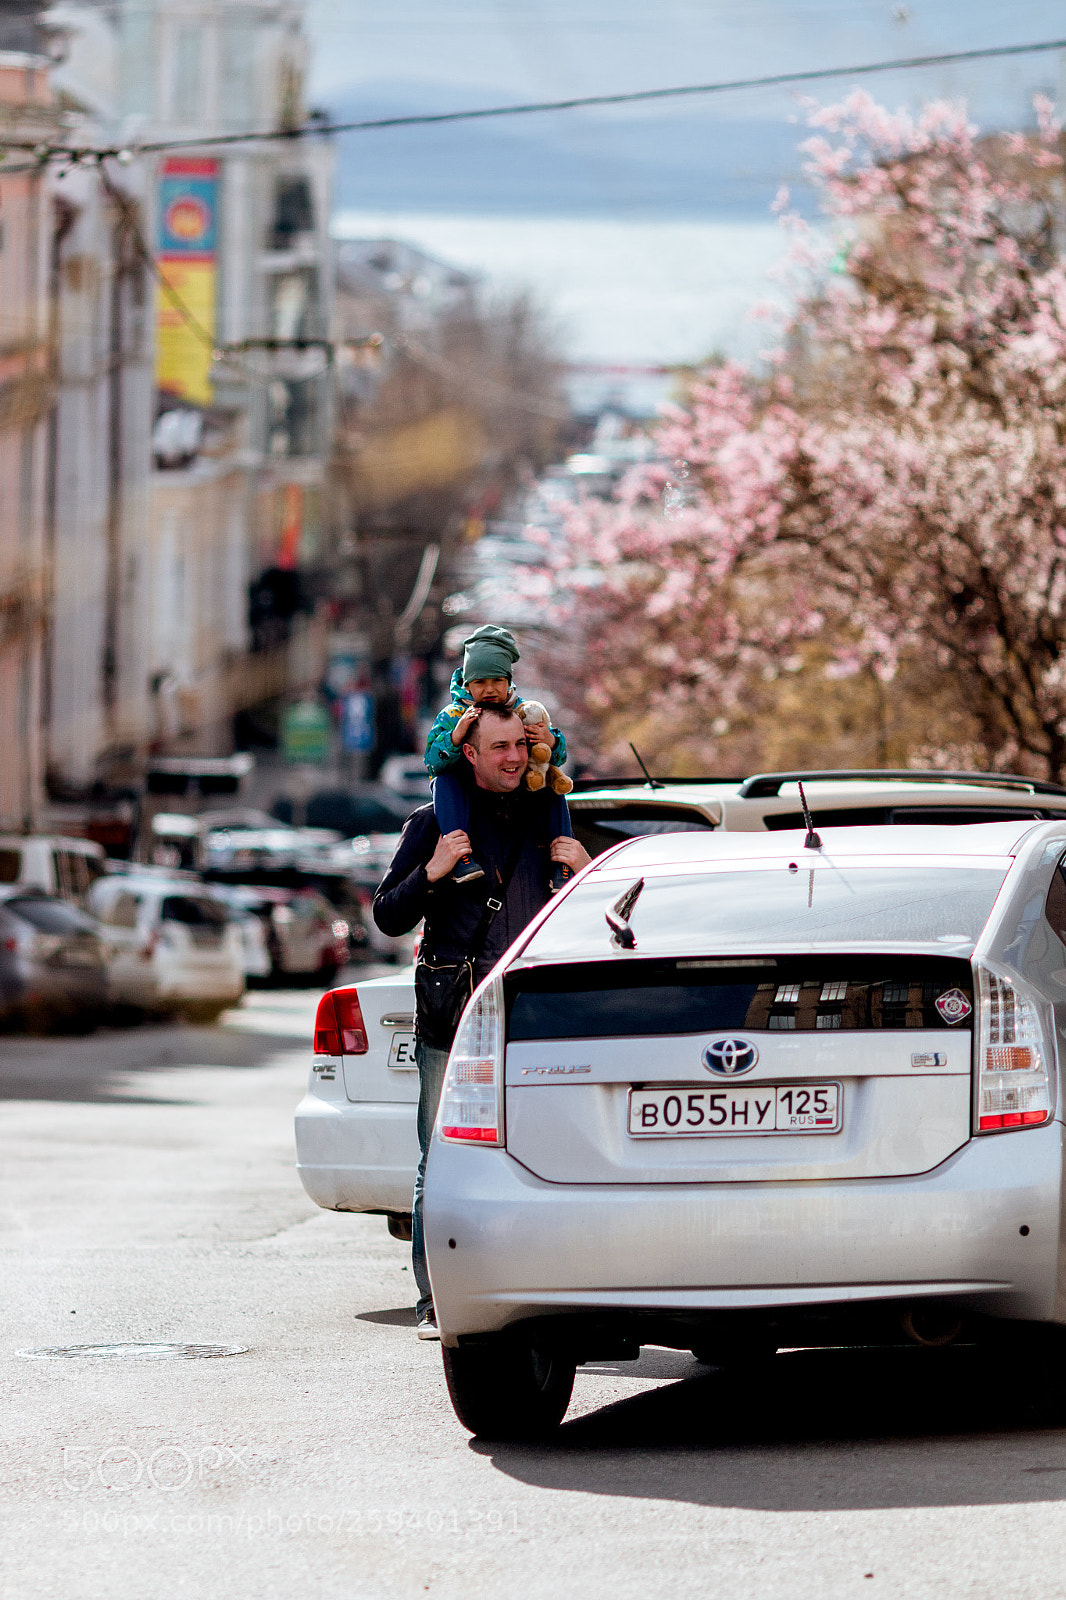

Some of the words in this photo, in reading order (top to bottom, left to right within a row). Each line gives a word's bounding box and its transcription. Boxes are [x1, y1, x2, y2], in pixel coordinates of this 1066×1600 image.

[521, 1064, 592, 1076] PRIUS
[779, 1089, 829, 1115] 125
[789, 1114, 814, 1125] RUS
